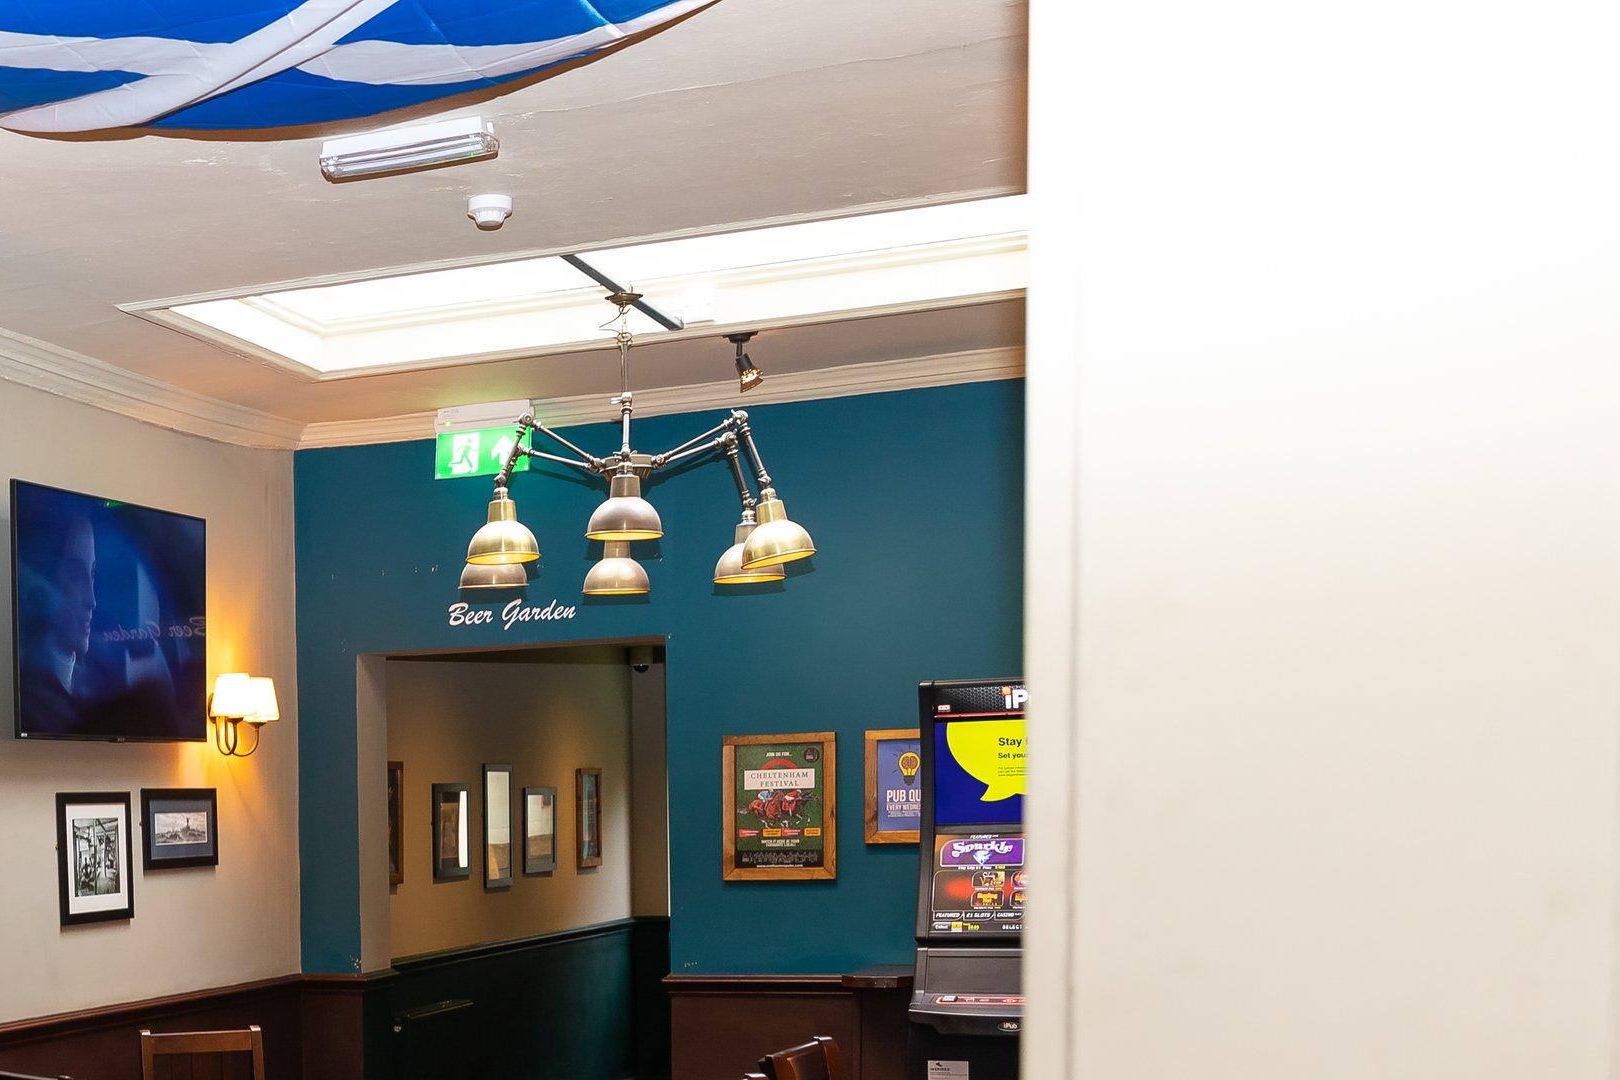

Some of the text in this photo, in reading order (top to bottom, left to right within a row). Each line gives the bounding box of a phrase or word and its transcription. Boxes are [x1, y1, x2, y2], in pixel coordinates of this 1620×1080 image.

[448, 598, 577, 631] Beer Garden
[998, 737, 1023, 748] Stay
[750, 771, 809, 779] CHELTENHAM
[760, 780, 800, 788] FESTIVAL
[886, 789, 907, 802] PUB
[951, 840, 1014, 858] Sparkle
